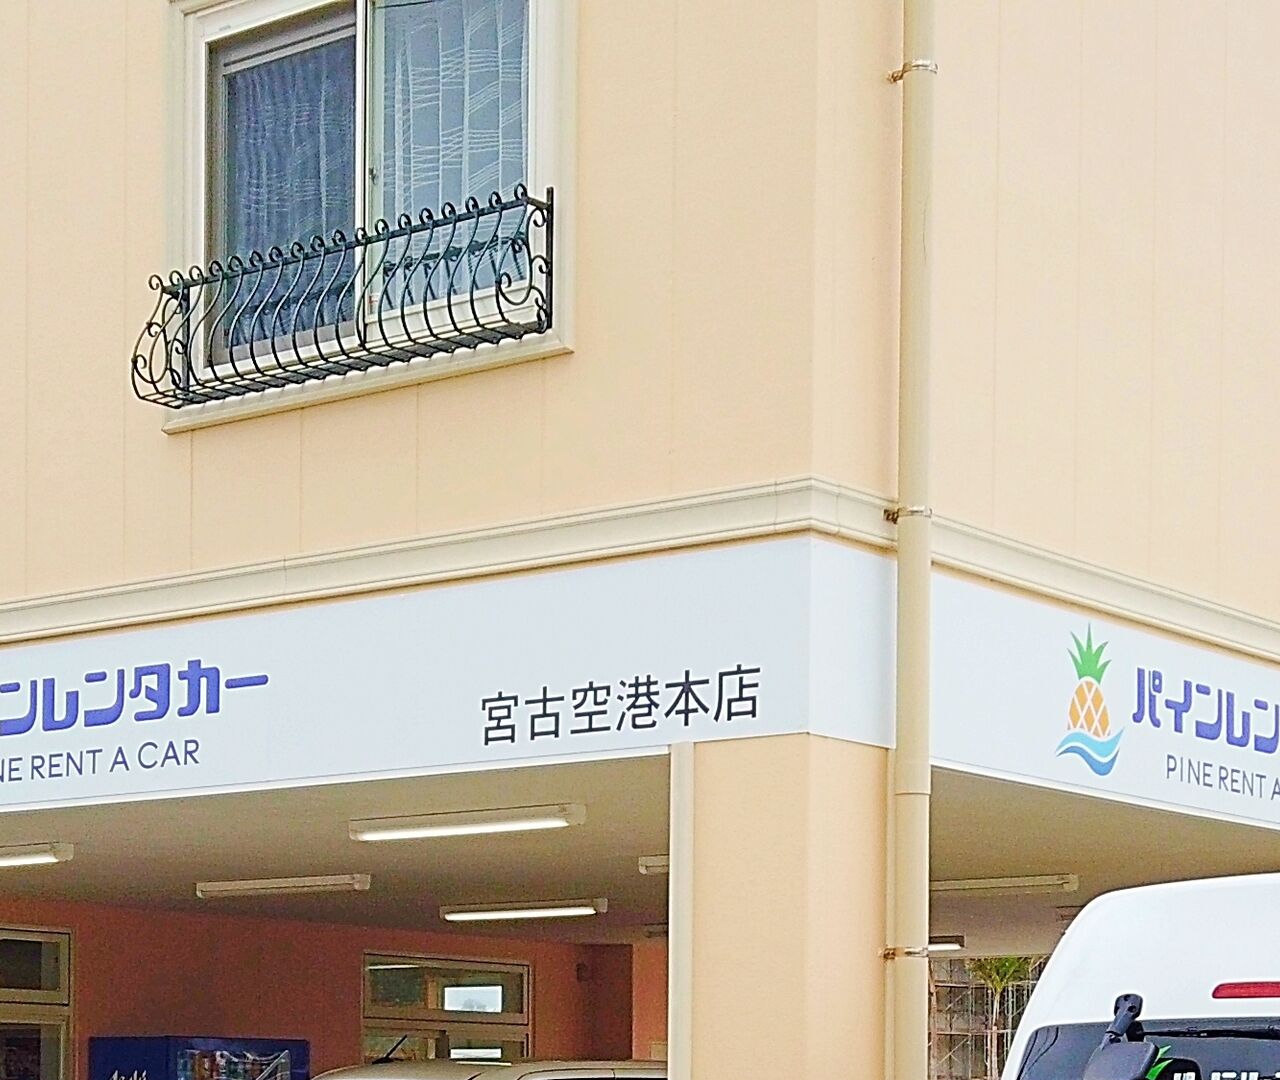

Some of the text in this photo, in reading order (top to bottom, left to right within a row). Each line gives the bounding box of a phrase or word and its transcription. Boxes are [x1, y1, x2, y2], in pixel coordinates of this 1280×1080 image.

[481, 663, 761, 746] 宮古空港本店
[30, 748, 103, 780] RENT
[109, 746, 129, 773] A
[138, 739, 200, 770] CAR
[1166, 754, 1213, 788] PINE
[1219, 765, 1266, 800] RENT
